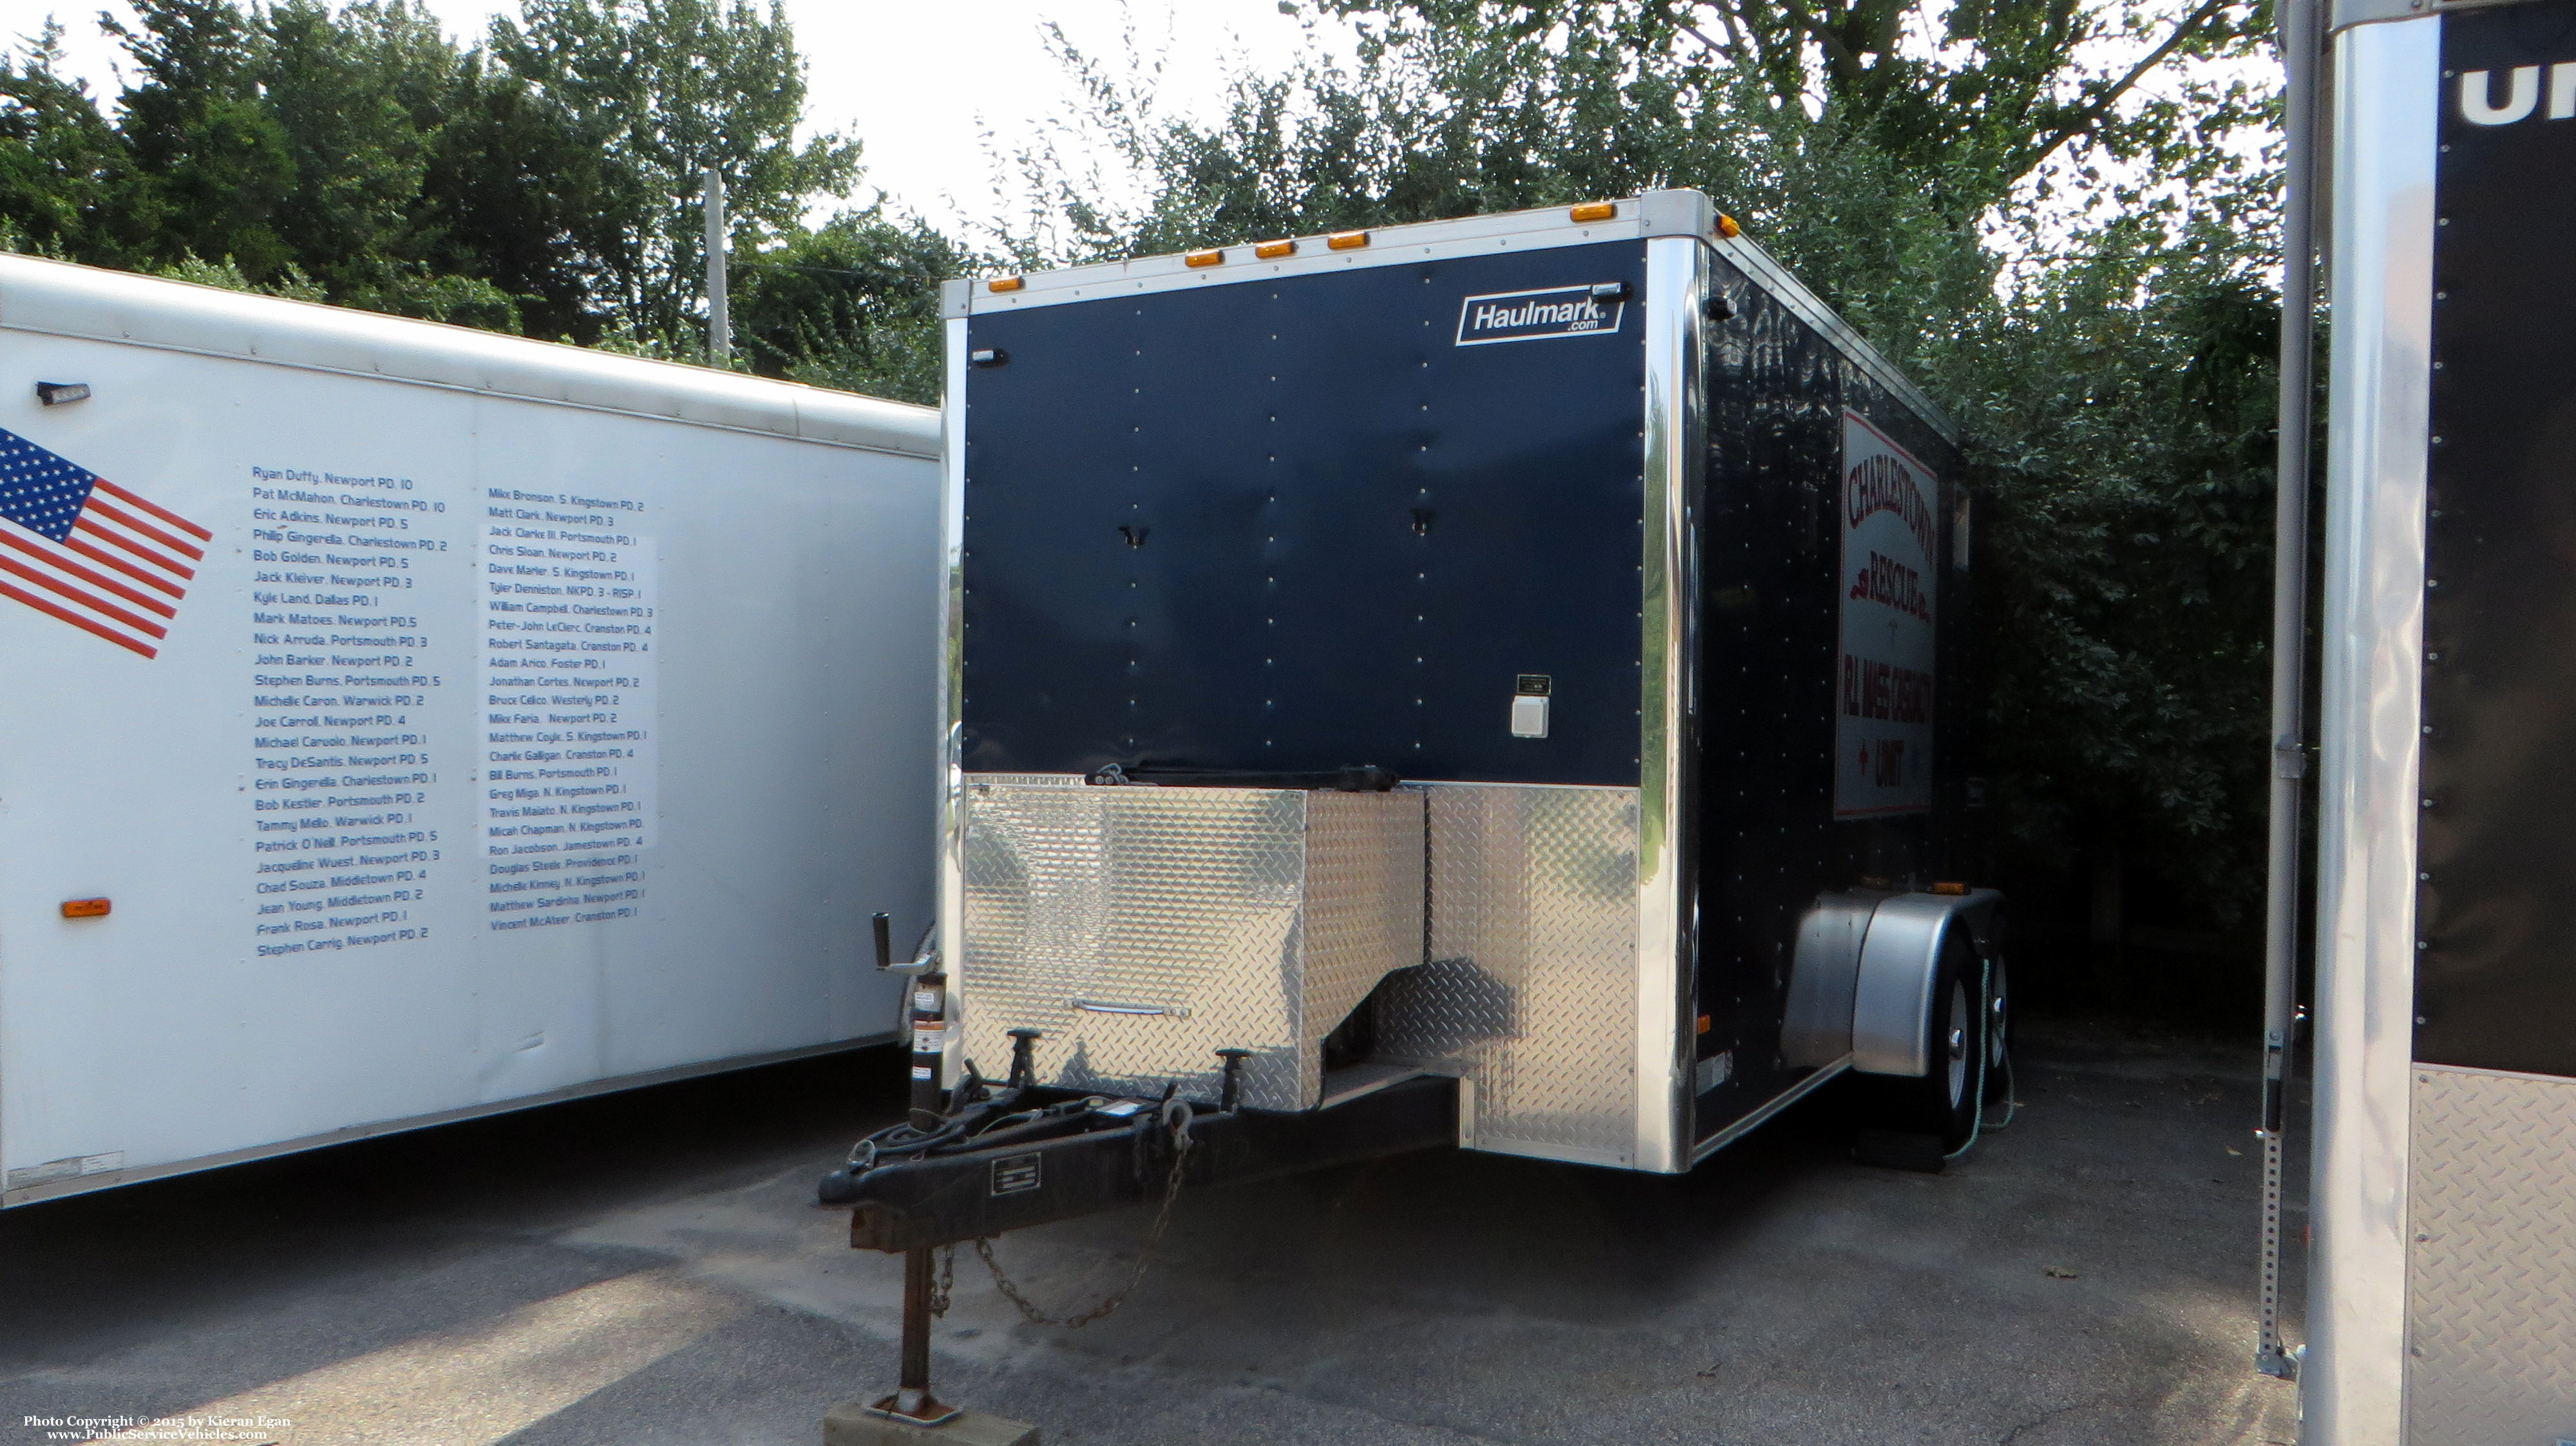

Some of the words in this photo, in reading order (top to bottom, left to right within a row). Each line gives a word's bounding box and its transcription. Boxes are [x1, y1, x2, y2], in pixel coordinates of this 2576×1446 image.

[1567, 319, 1599, 331] .com
[253, 466, 283, 480] Ryan
[325, 473, 375, 487] Newport
[253, 487, 274, 499] Pat
[340, 494, 409, 509] Charlestown
[489, 488, 510, 499] Mike
[571, 496, 618, 509] Kingstown
[638, 502, 643, 511] 2
[254, 508, 276, 520] Eric
[325, 514, 375, 527] Newport
[401, 518, 407, 529] 5
[489, 507, 513, 518] Matt
[546, 511, 587, 523] Newport
[608, 516, 613, 526] 3
[1848, 454, 1933, 570] CHARLESTOWN
[489, 526, 511, 536] Jack
[560, 531, 614, 543] Portsmouth
[348, 535, 417, 548] Charlestown
[440, 541, 446, 551] 2
[254, 549, 278, 561] Bob
[327, 554, 376, 567] Newport
[401, 558, 408, 568] 5
[489, 544, 513, 555] Chris
[549, 549, 590, 560] Newport
[611, 552, 616, 562] 2
[255, 571, 281, 582] Jack
[331, 574, 381, 587] Newport
[406, 577, 412, 588] 3
[489, 563, 513, 574] Dave
[564, 568, 613, 580] Kingstown
[490, 581, 511, 594] Tyler
[598, 587, 603, 597] 3
[1870, 550, 1918, 615] RESCUE
[254, 592, 277, 605] Kyle
[316, 594, 348, 605] Dallas
[490, 601, 522, 612] William
[573, 604, 628, 615] Charlestown
[647, 608, 652, 617] 3
[254, 612, 285, 623] Mark
[339, 615, 388, 627] Newport
[489, 619, 543, 630] Peter-John
[585, 623, 624, 634] Cranston
[645, 626, 650, 634] 4
[254, 633, 278, 644] Nick
[331, 635, 396, 646] Portsmouth
[421, 636, 427, 647] 3
[489, 638, 521, 648] Robert
[582, 641, 620, 651] Cranston
[642, 643, 647, 651] 4
[256, 654, 283, 664] John
[332, 655, 381, 667] Newport
[405, 655, 412, 666] 2
[490, 657, 517, 667] Adam
[551, 658, 582, 668] Foster
[256, 674, 302, 686] Stephen
[345, 675, 409, 686] Portsmouth
[433, 675, 440, 686] 5
[490, 677, 534, 686] Jonathan
[573, 677, 614, 688] Newport
[633, 677, 638, 687] 2
[254, 695, 300, 706] Michelle
[344, 695, 392, 706] Warwick
[416, 695, 423, 706] 2
[489, 695, 516, 704] Bruce
[552, 695, 592, 706] Westerly
[613, 695, 619, 705] 2
[256, 717, 276, 727] Joe
[325, 715, 372, 728] Newport
[398, 715, 405, 724] 4
[489, 713, 511, 724] Mike
[549, 713, 590, 724] Newport
[611, 713, 616, 722] 2
[255, 737, 298, 747] Michael
[351, 735, 398, 747] Newport
[489, 733, 533, 742] Matthew
[578, 731, 625, 742] Kingstown
[256, 758, 287, 770] Tracy
[348, 756, 397, 767] Newport
[421, 753, 428, 764] 5
[566, 749, 607, 759] Cranston
[627, 749, 633, 757] 4
[490, 770, 502, 780] Bill
[539, 767, 595, 778] Portsmouth
[256, 778, 278, 789] Erin
[343, 775, 410, 786] Charlestown
[556, 787, 603, 798] Kingstown
[256, 800, 279, 811] Bob
[328, 794, 393, 806] Portsmouth
[417, 792, 424, 803] 2
[491, 807, 519, 817] Travis
[572, 803, 619, 815] Kingstown
[257, 820, 297, 831] Tammy
[335, 815, 383, 826] Warwick
[580, 822, 627, 832] Kingstown
[256, 840, 298, 852] Patrick
[341, 834, 405, 846] Portsmouth
[430, 831, 437, 841] 5
[490, 845, 508, 856] Ron
[564, 840, 615, 850] Jamestown
[636, 836, 642, 845] 4
[361, 853, 408, 865] Newport
[433, 849, 439, 860] 3
[566, 857, 616, 867] Providence
[258, 881, 287, 894] Chad
[331, 874, 393, 887] Middletown
[419, 869, 426, 879] 4
[490, 881, 527, 893] Michelle
[576, 875, 623, 887] Kingstown
[328, 894, 391, 907] Middletown
[415, 888, 422, 899] 2
[491, 901, 534, 912] Matthew
[584, 892, 621, 903] Newport
[257, 923, 290, 935] Frank
[330, 914, 378, 927] Newport
[491, 918, 527, 930] Vincent
[576, 911, 615, 922] Cranston
[258, 943, 303, 956] Stephen
[348, 932, 396, 945] Newport
[421, 927, 427, 937] 2
